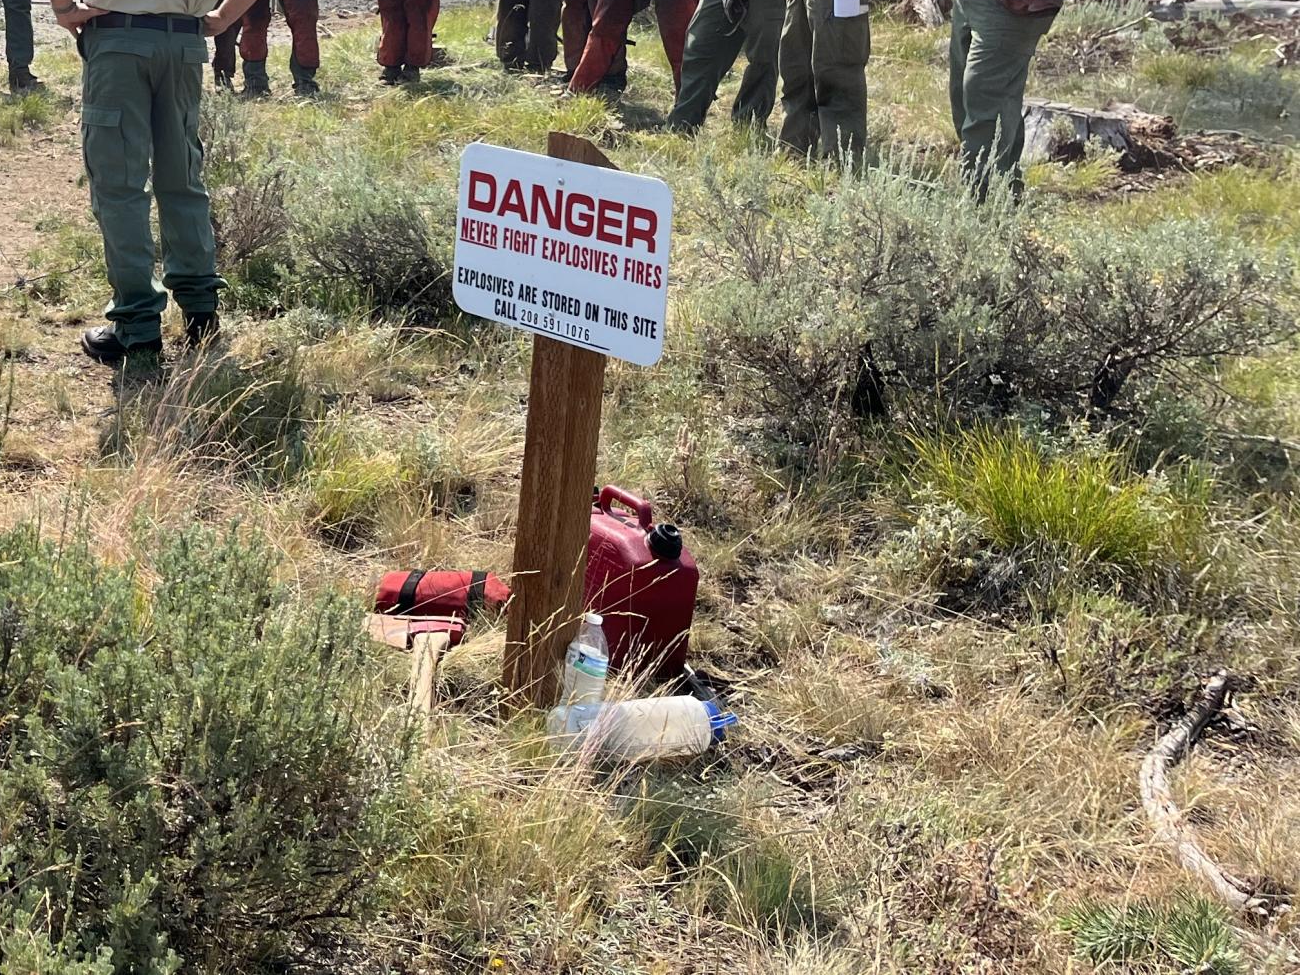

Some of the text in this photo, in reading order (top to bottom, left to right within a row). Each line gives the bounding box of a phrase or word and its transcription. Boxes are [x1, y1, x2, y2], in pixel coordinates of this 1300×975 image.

[468, 170, 658, 253] DANGER
[460, 217, 662, 289] NEVER FIGHT EXPLOSIVES FIRES
[458, 267, 657, 339] EXPLOSIVES ARE STORED ON THIS SITE
[494, 298, 590, 341] CALL 208 591 1076
